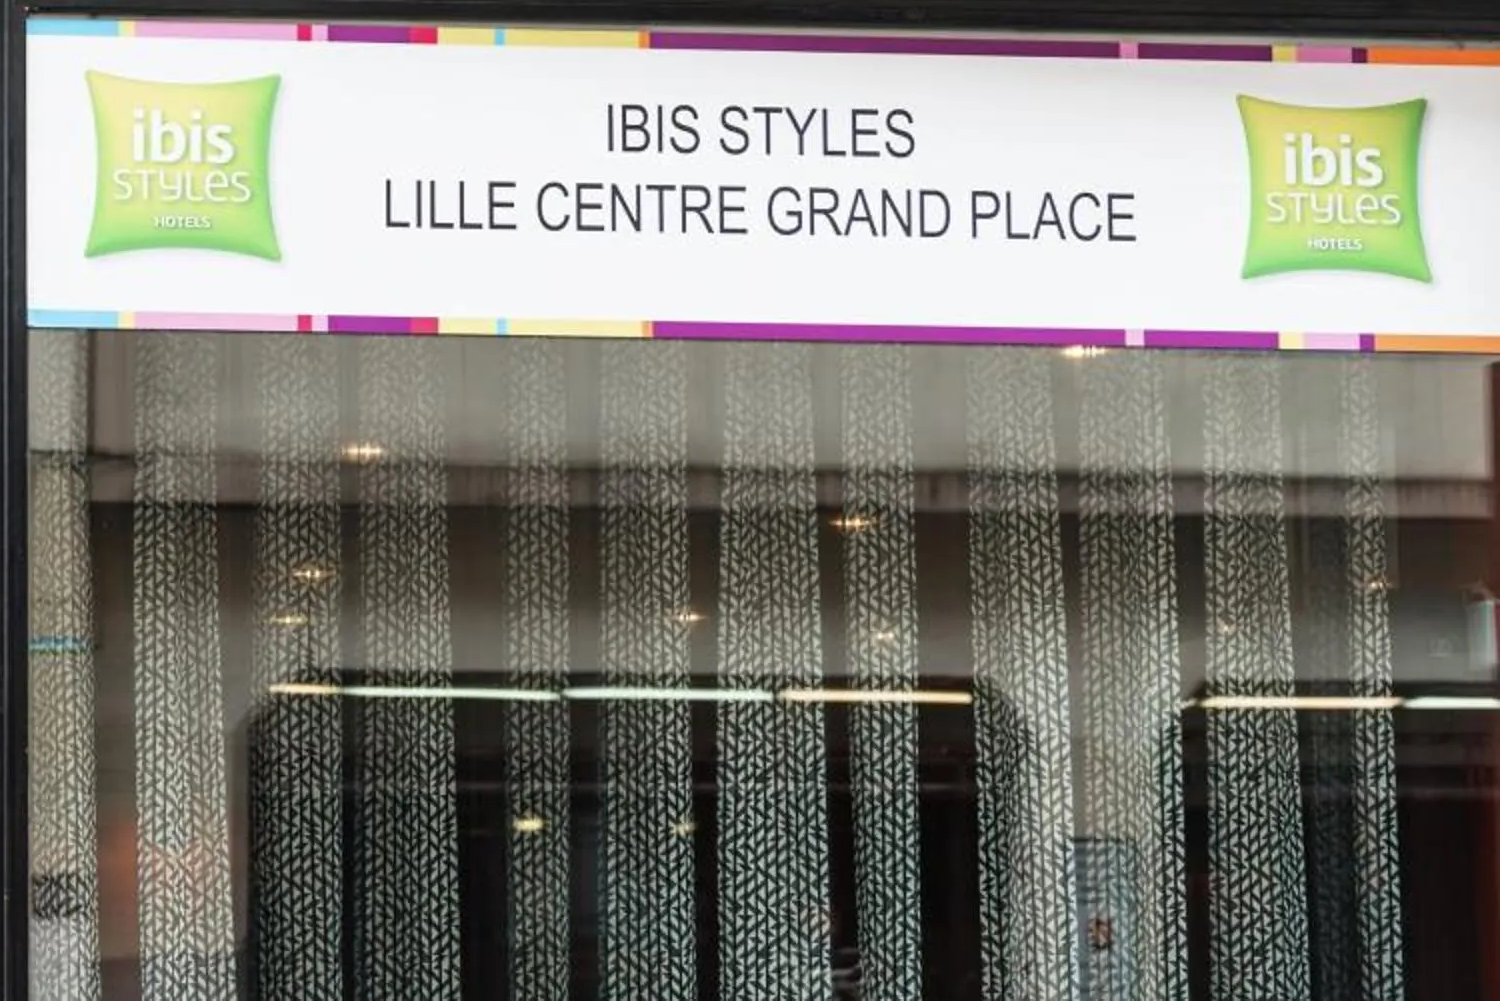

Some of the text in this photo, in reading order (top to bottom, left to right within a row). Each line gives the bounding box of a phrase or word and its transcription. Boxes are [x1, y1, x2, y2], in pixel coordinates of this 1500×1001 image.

[132, 108, 236, 164] ibis
[606, 103, 916, 158] IBIS STYLES
[1281, 131, 1384, 188] ibis
[153, 214, 212, 230] HOTELS
[384, 179, 1138, 242] LILLE CENTRE GRAND PLACE
[1306, 235, 1364, 251] HOTELS
